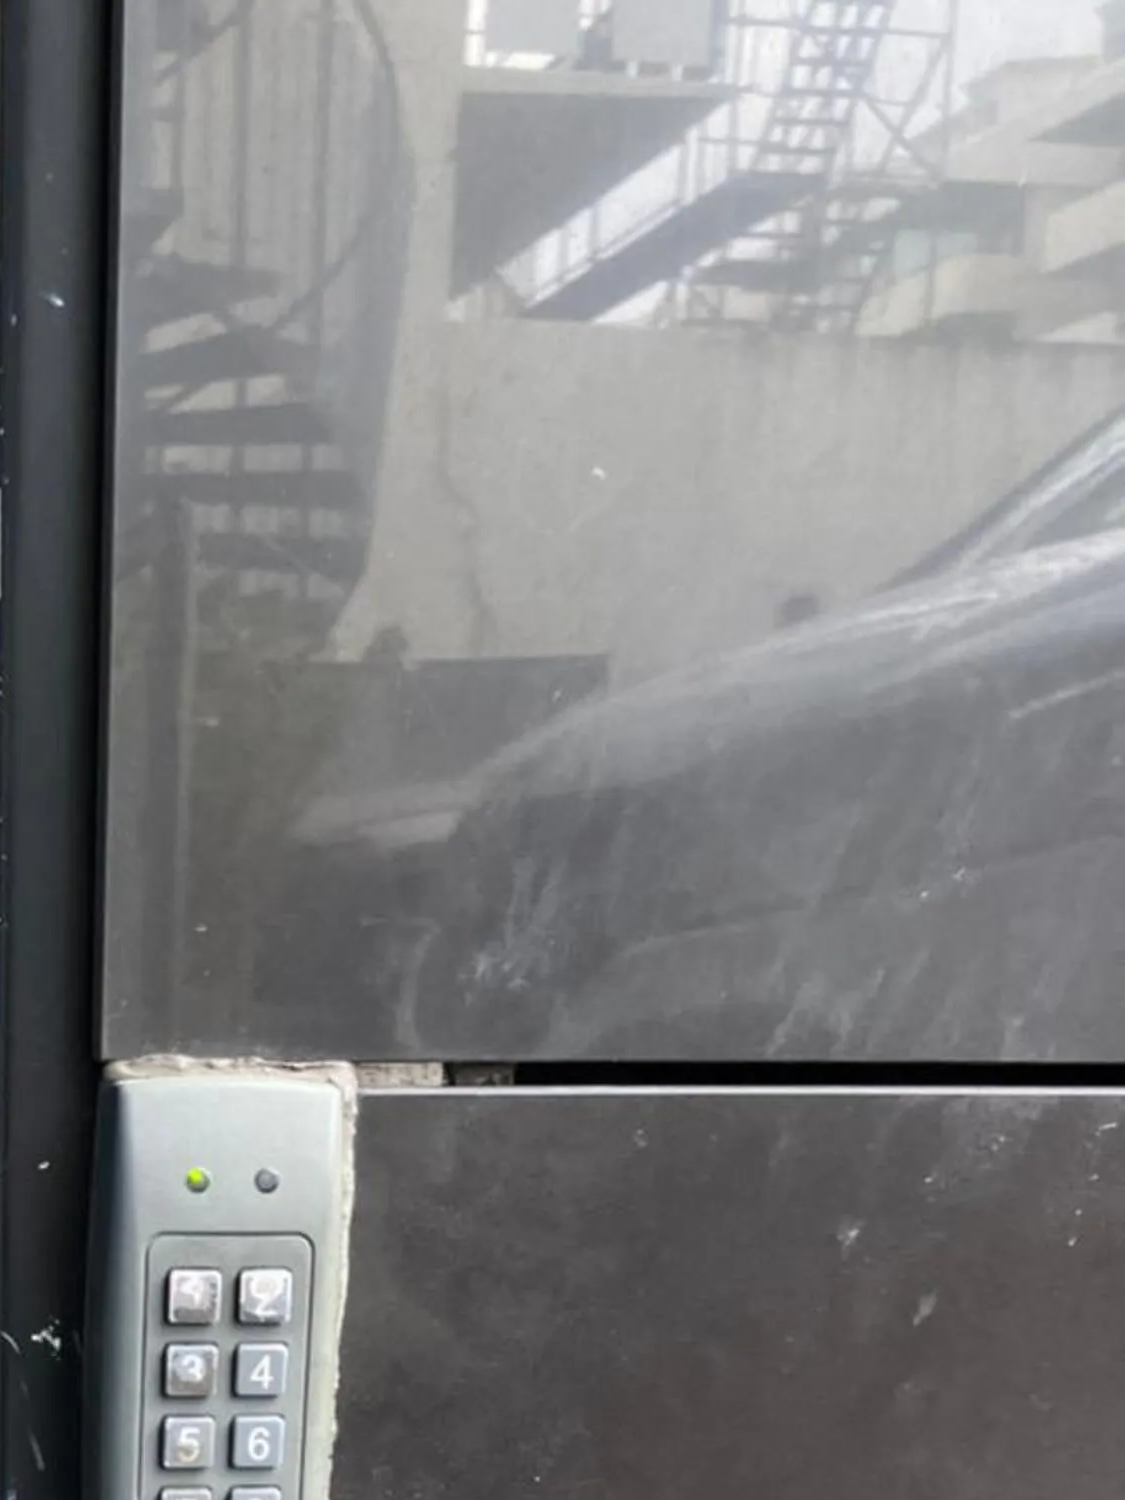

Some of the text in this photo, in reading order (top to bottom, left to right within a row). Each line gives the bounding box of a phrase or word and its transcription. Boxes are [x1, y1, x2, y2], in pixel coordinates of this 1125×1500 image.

[250, 1354, 274, 1390] 4
[178, 1426, 271, 1462] 5 6
